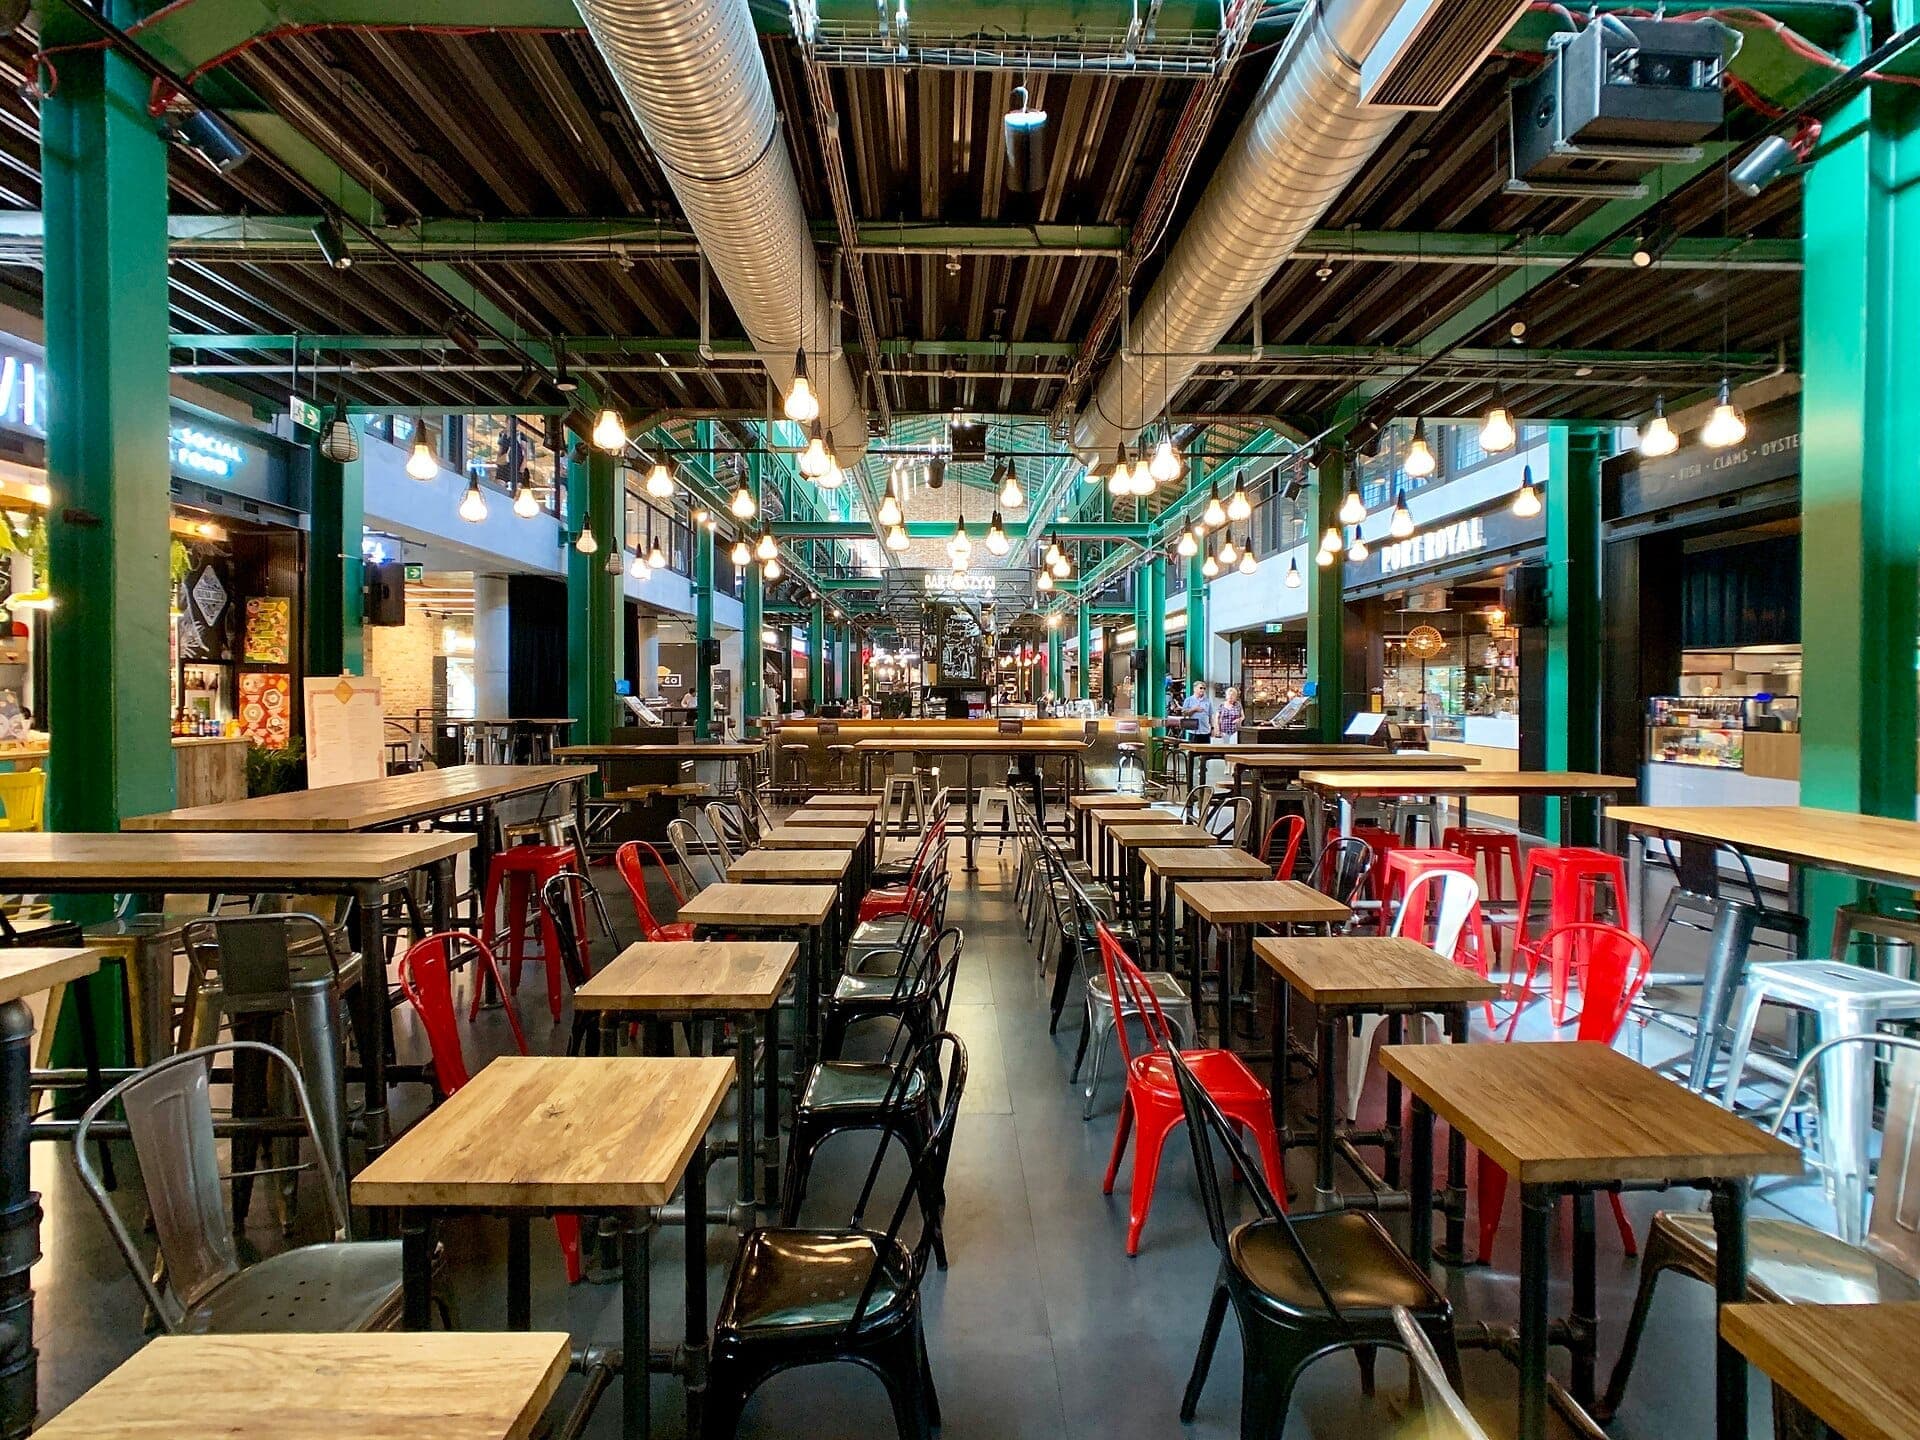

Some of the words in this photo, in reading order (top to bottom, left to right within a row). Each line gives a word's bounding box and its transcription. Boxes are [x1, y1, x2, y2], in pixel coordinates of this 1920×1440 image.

[178, 447, 229, 475] FOOD
[1713, 449, 1749, 470] CLAMS
[1760, 433, 1800, 456] OYSTE
[1382, 534, 1424, 573] PORT
[1424, 516, 1487, 562] ROYAL
[946, 574, 996, 590] KSZYKI
